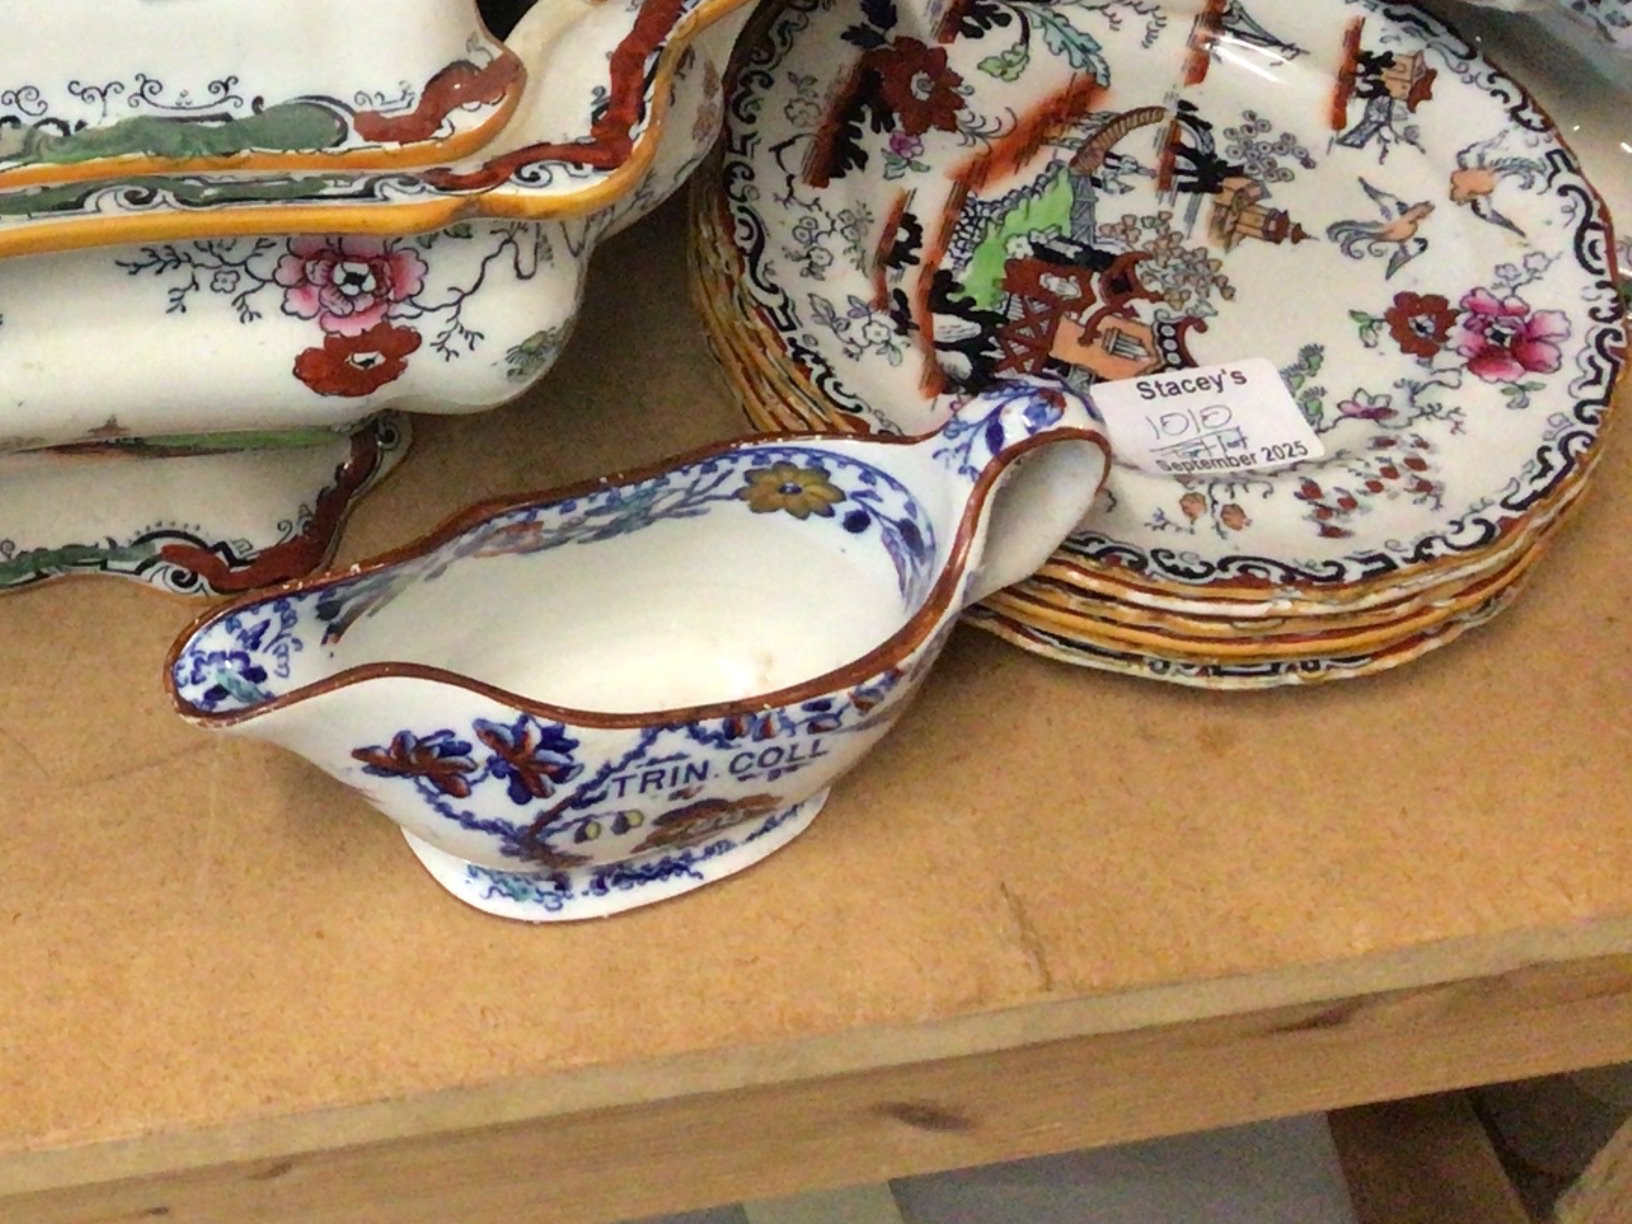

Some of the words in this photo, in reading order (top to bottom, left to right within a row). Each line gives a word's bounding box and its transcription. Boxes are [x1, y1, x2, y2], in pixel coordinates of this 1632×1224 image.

[1137, 369, 1248, 401] Stacey's
[1155, 450, 1257, 473] September
[1261, 440, 1309, 462] 2025
